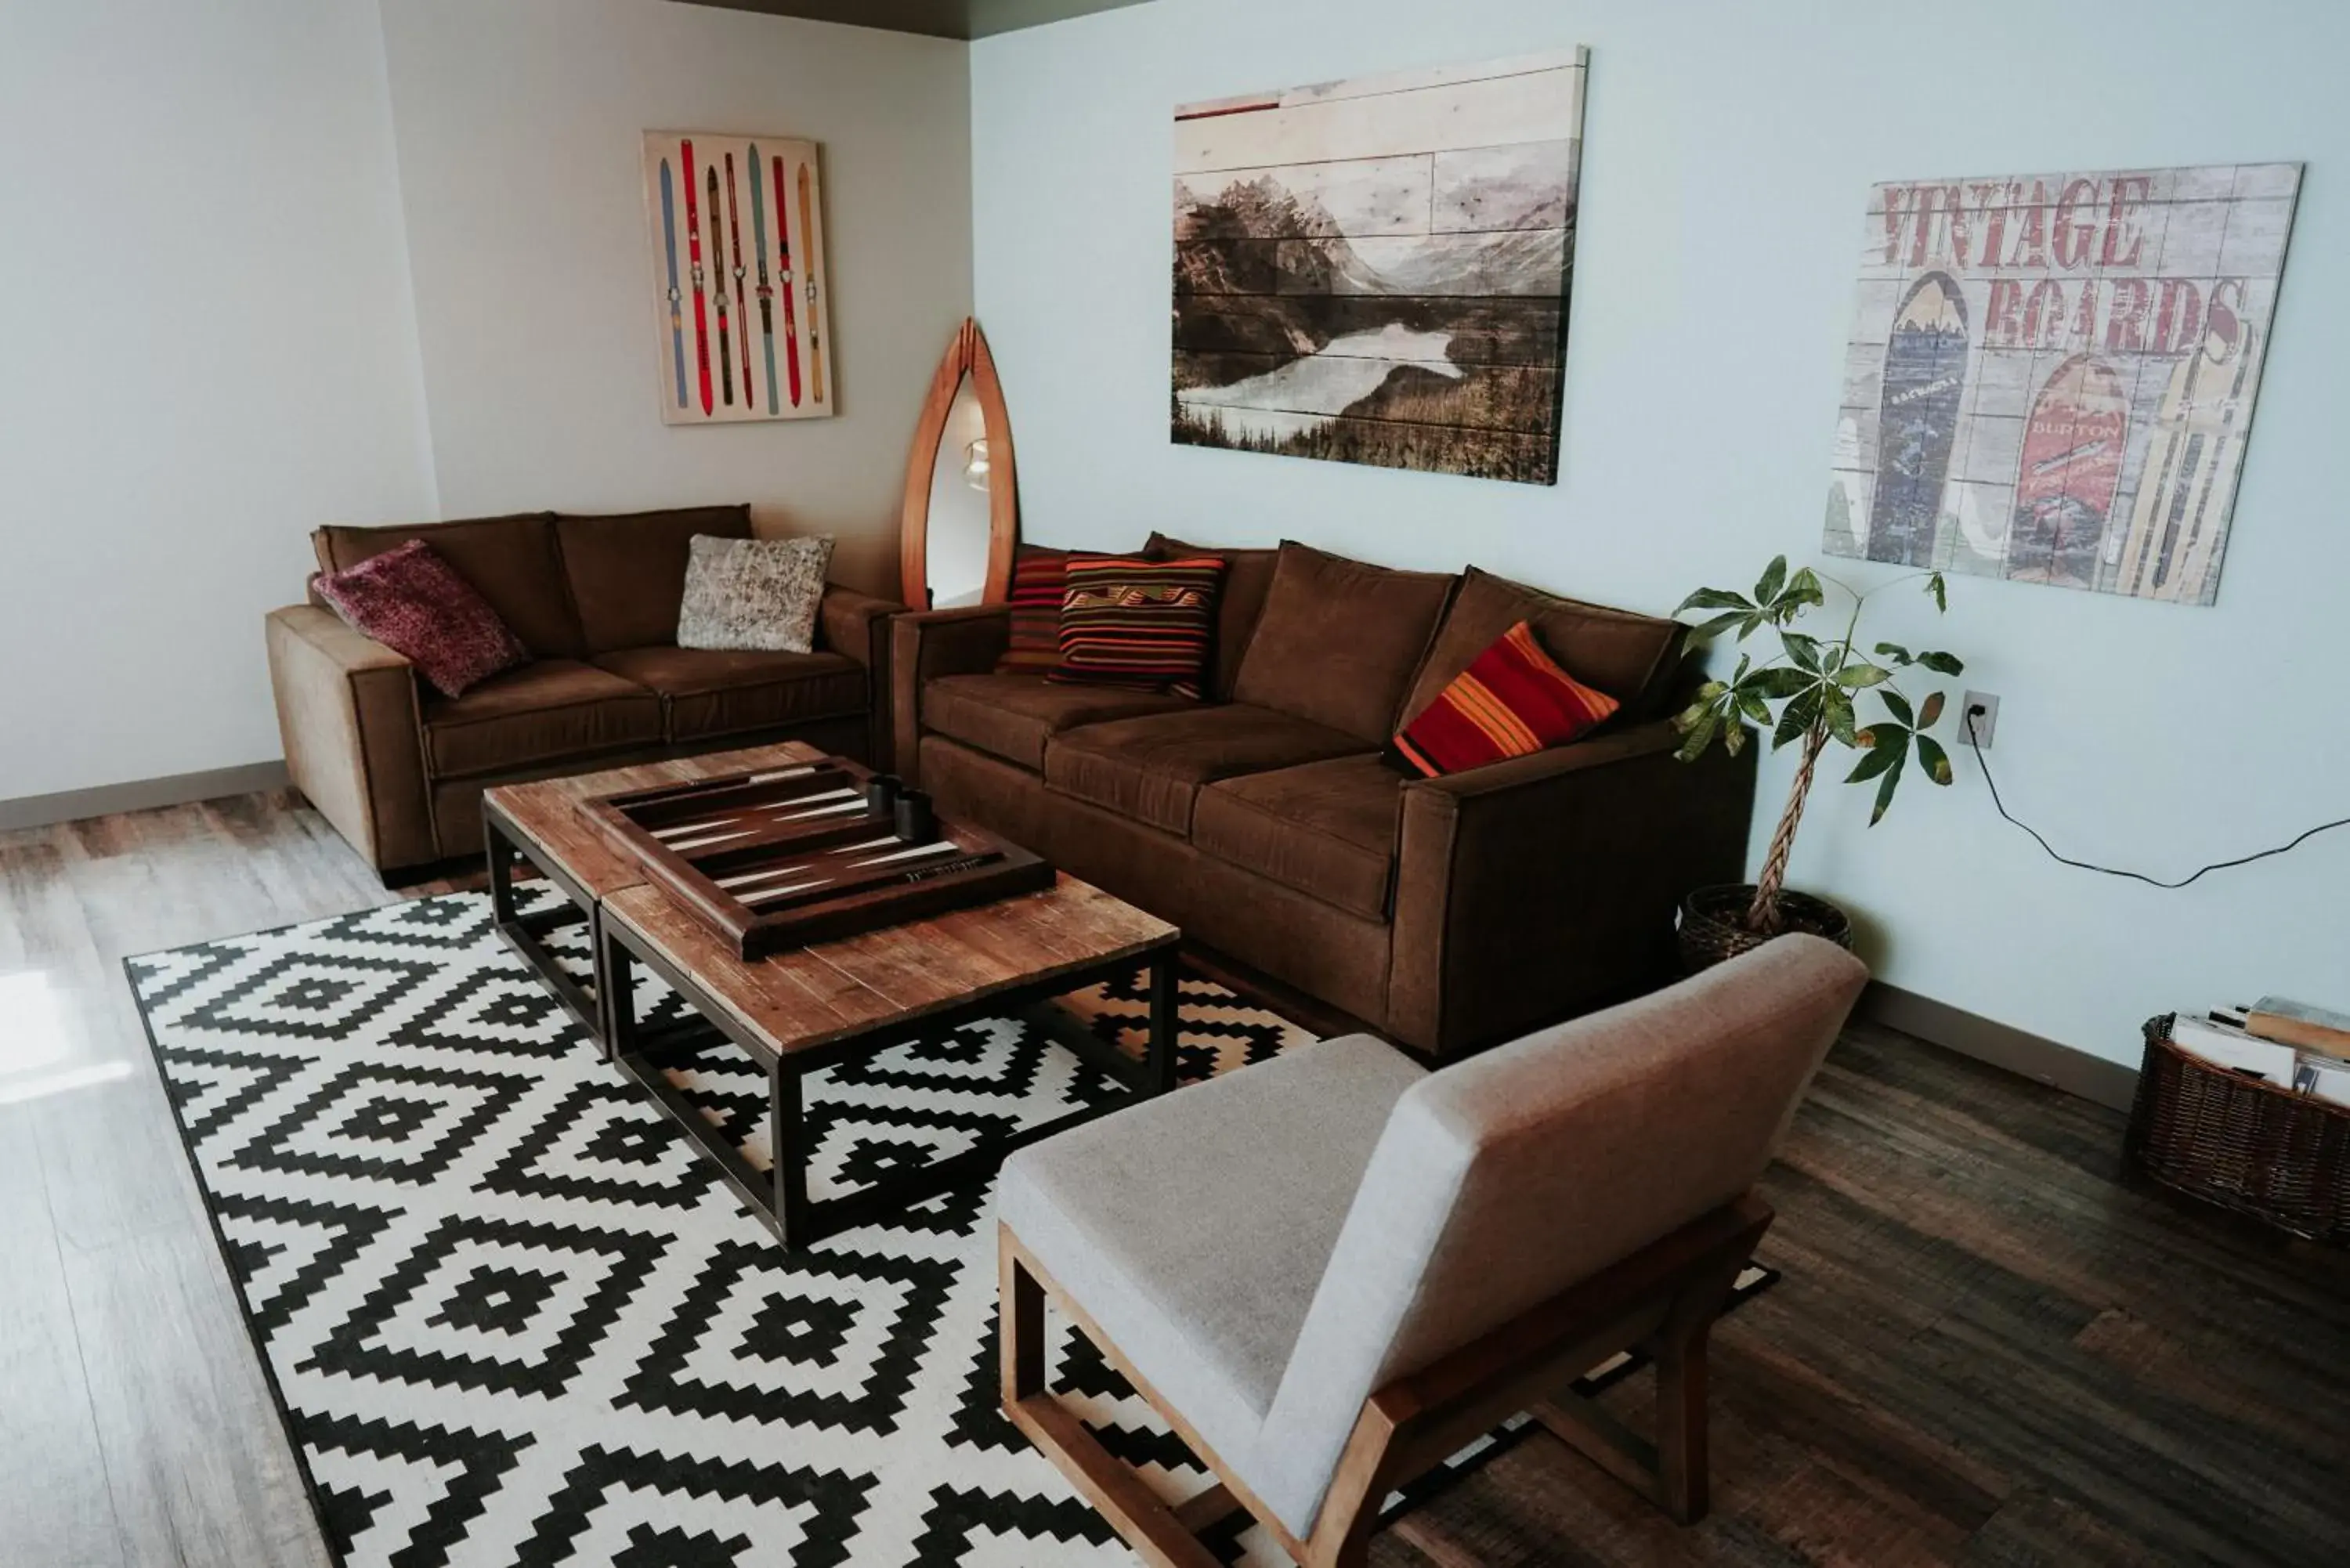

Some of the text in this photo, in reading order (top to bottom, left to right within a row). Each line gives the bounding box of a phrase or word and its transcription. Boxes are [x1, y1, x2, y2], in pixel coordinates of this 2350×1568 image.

[1882, 176, 2153, 271] VINTAGE
[1980, 276, 2247, 362] BOARDS
[2031, 421, 2120, 439] BURTON
